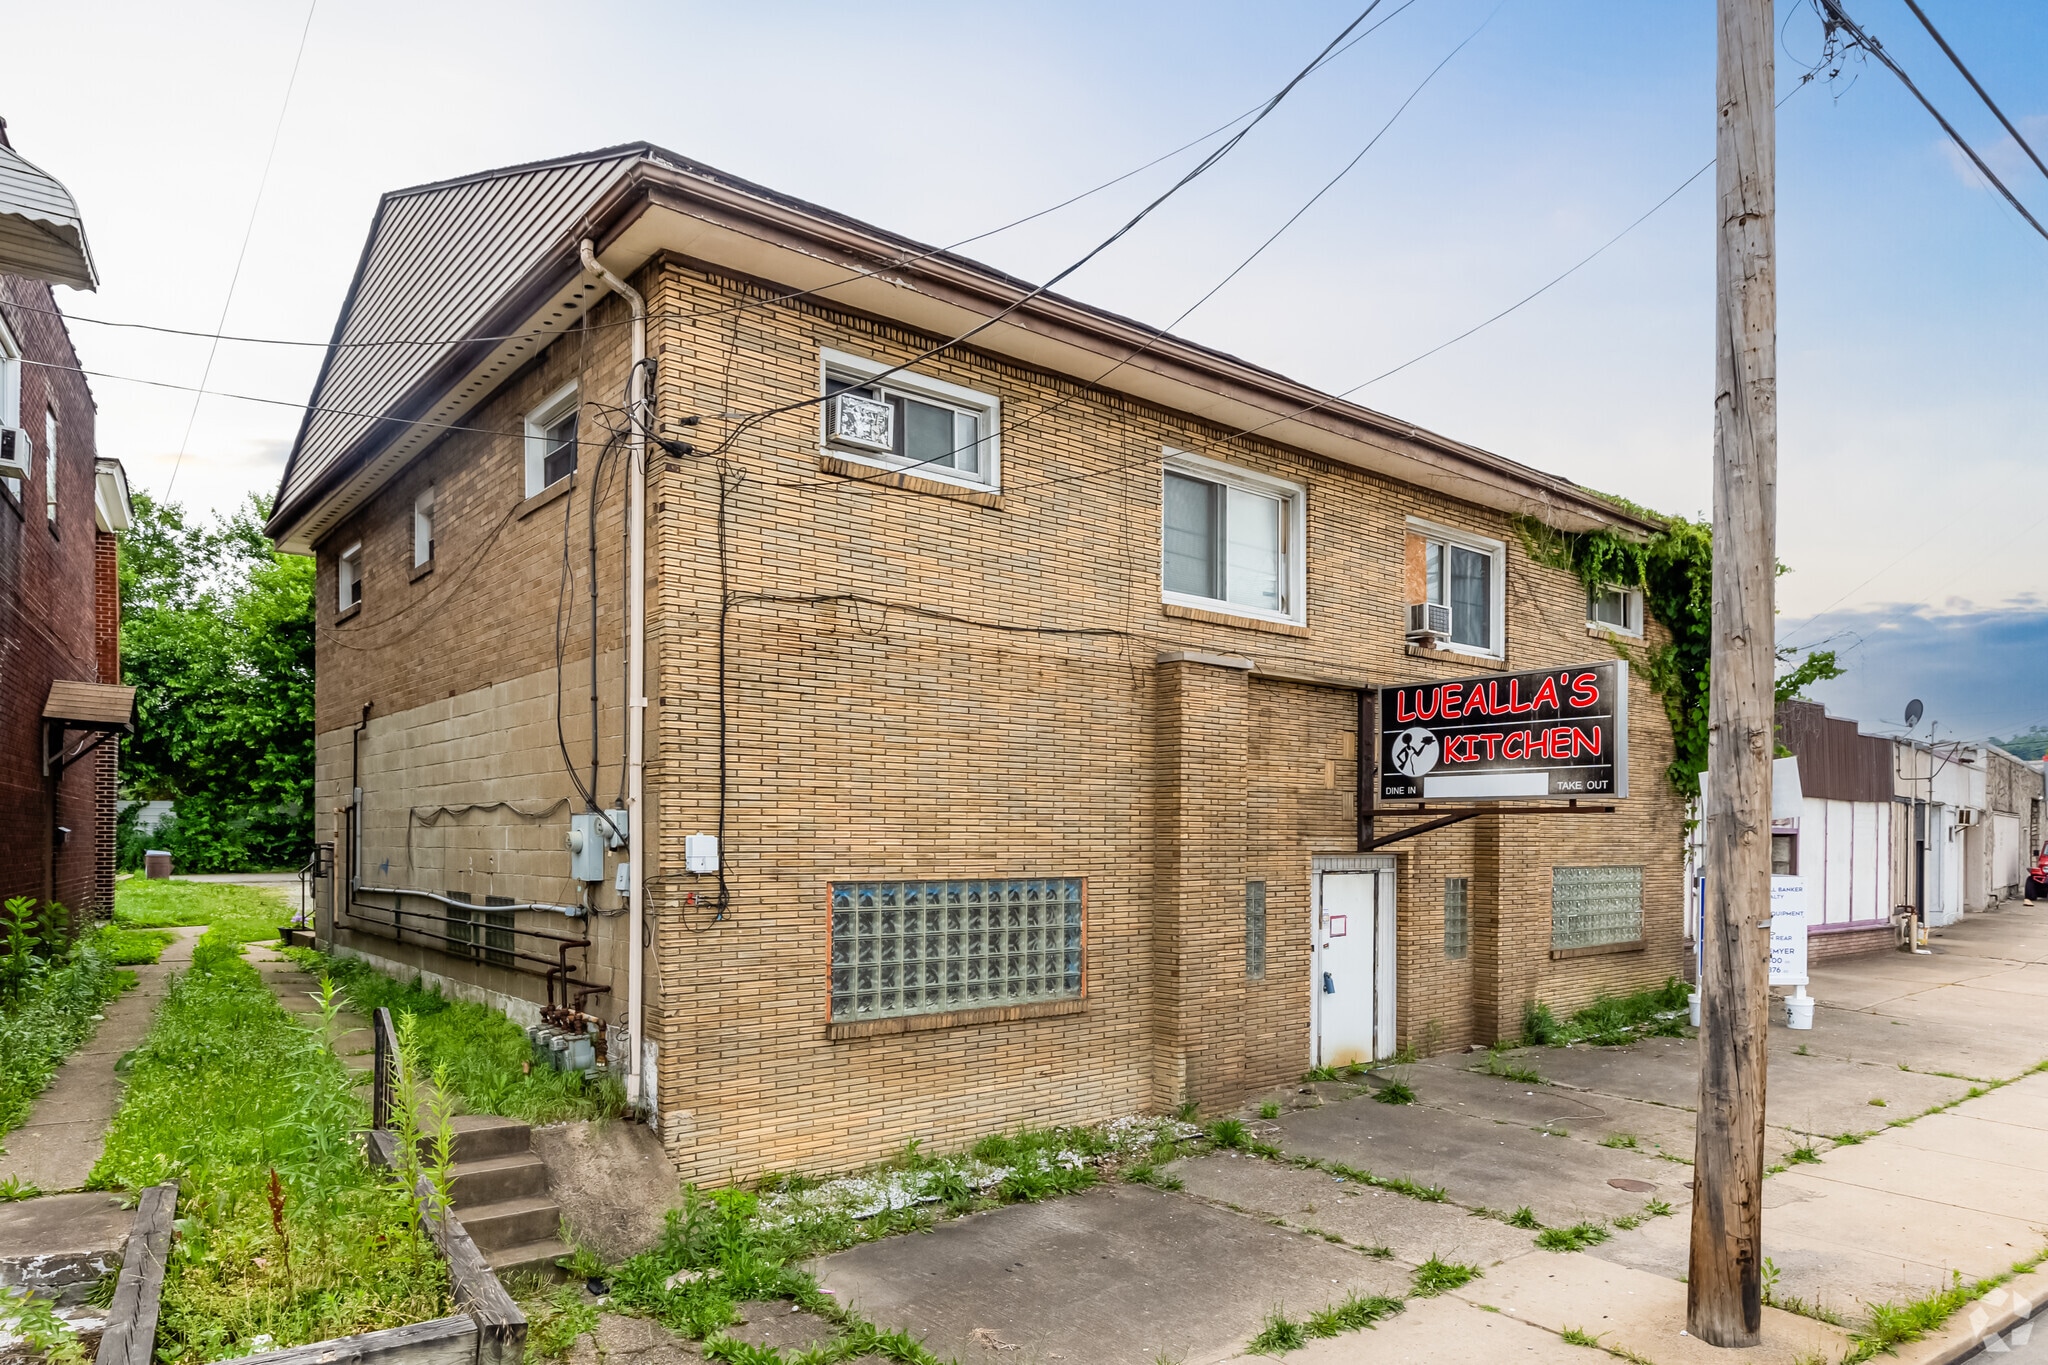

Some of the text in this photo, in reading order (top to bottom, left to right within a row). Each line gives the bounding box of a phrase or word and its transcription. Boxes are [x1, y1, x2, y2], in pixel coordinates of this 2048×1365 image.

[1397, 673, 1599, 722] LUEALLA'S
[1443, 726, 1601, 764] KITCHEN
[1385, 786, 1416, 795] DINE IN
[1557, 780, 1609, 790] TAKE OUT
